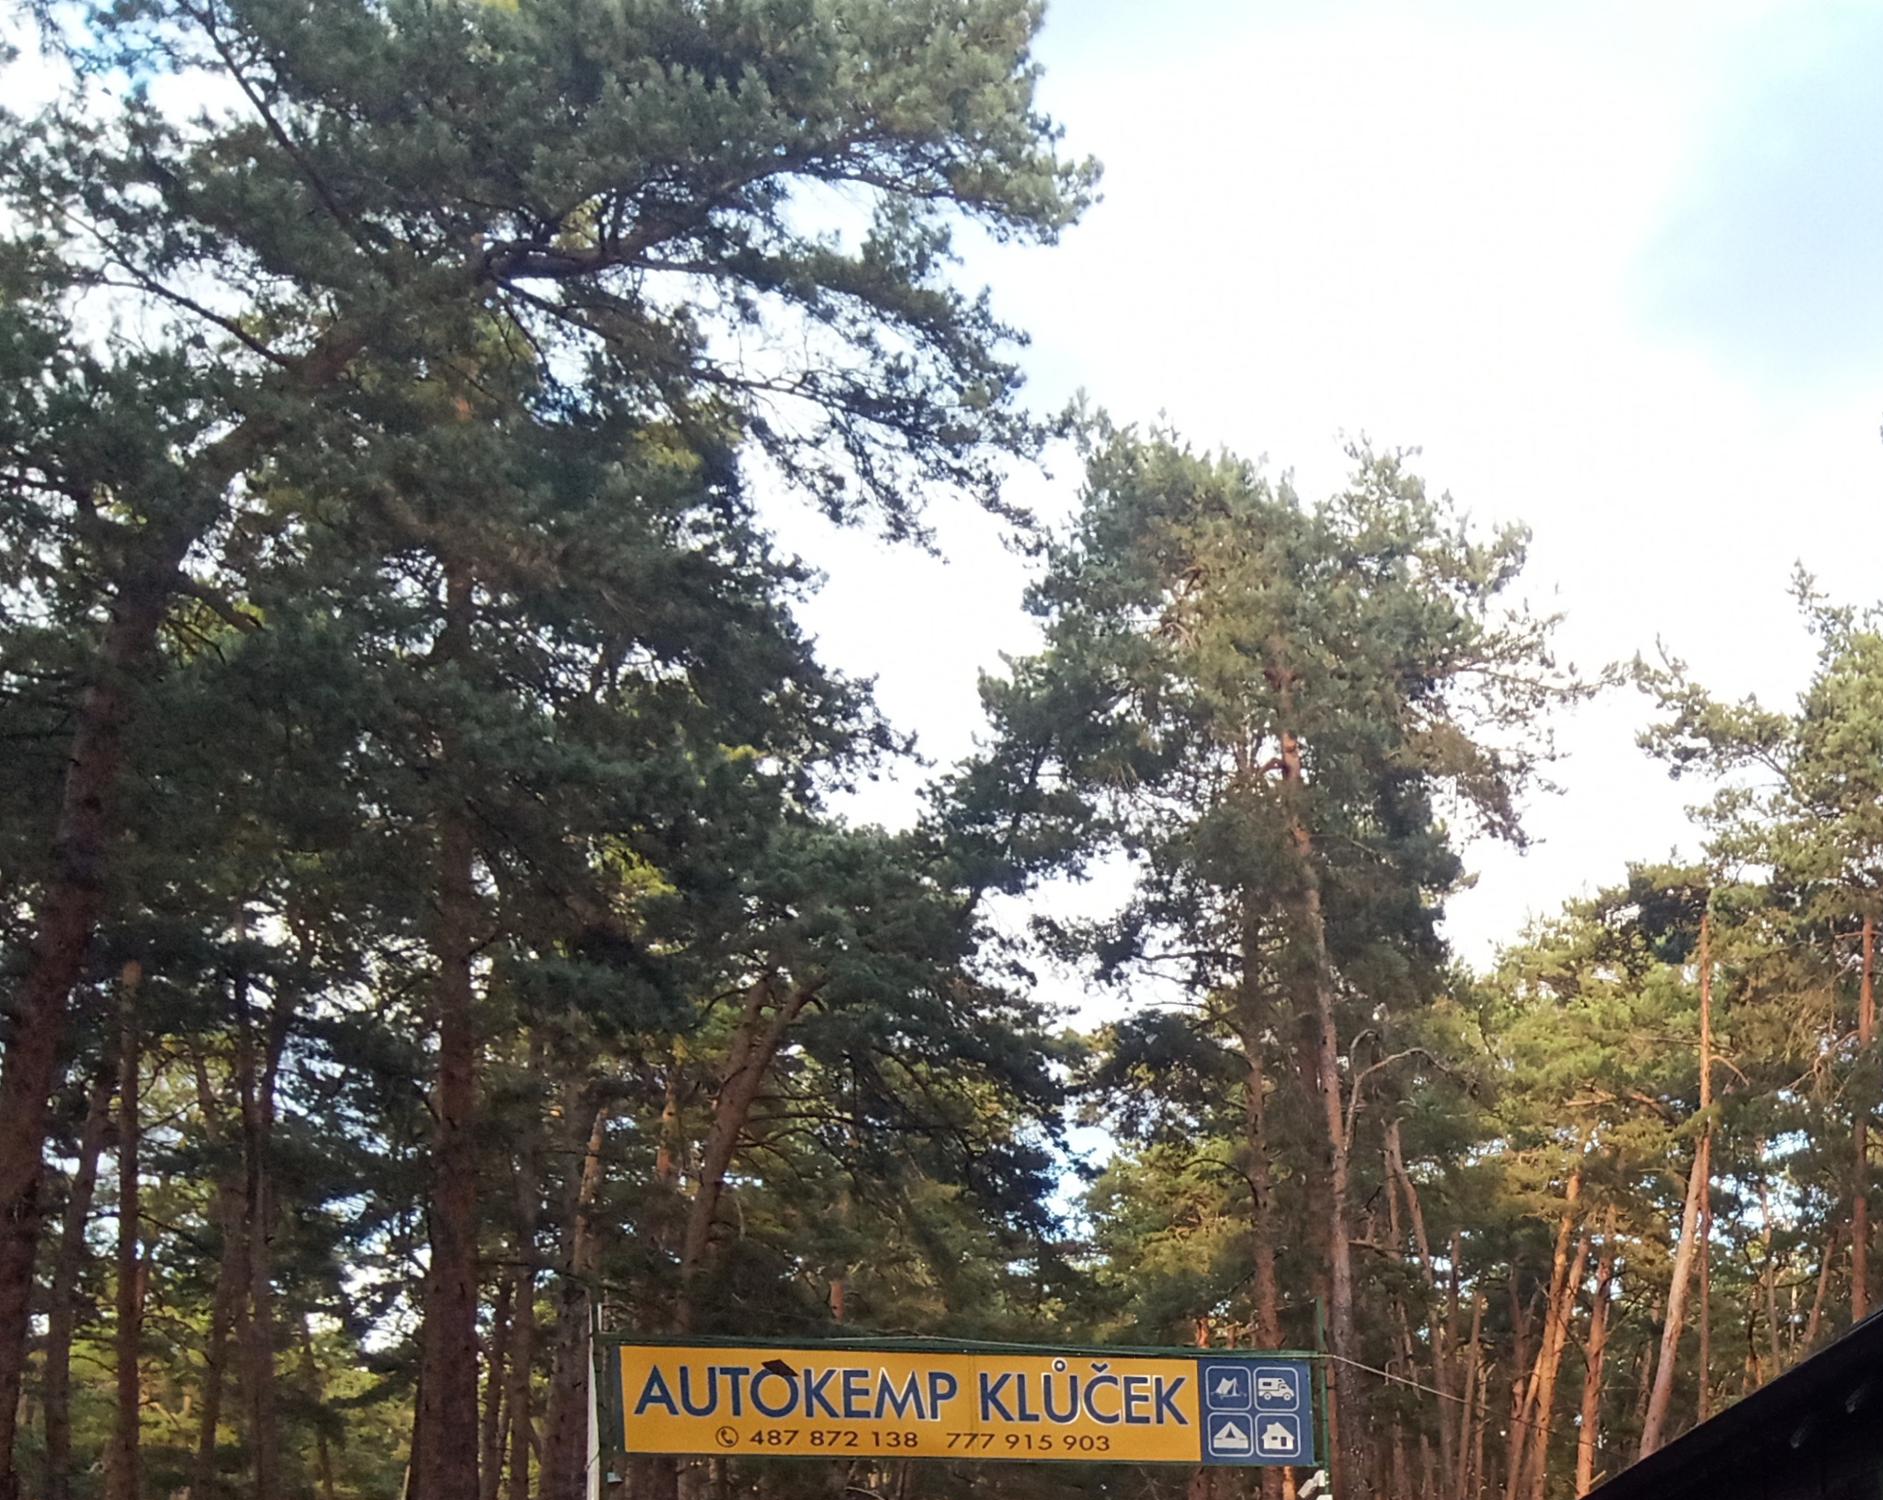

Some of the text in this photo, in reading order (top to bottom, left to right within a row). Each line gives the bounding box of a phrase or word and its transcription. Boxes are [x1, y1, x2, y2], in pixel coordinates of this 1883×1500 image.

[633, 1358, 1190, 1425] AUTOKEMP KLŮČEK
[749, 1430, 1110, 1451] 487 872 138 777 915 903
